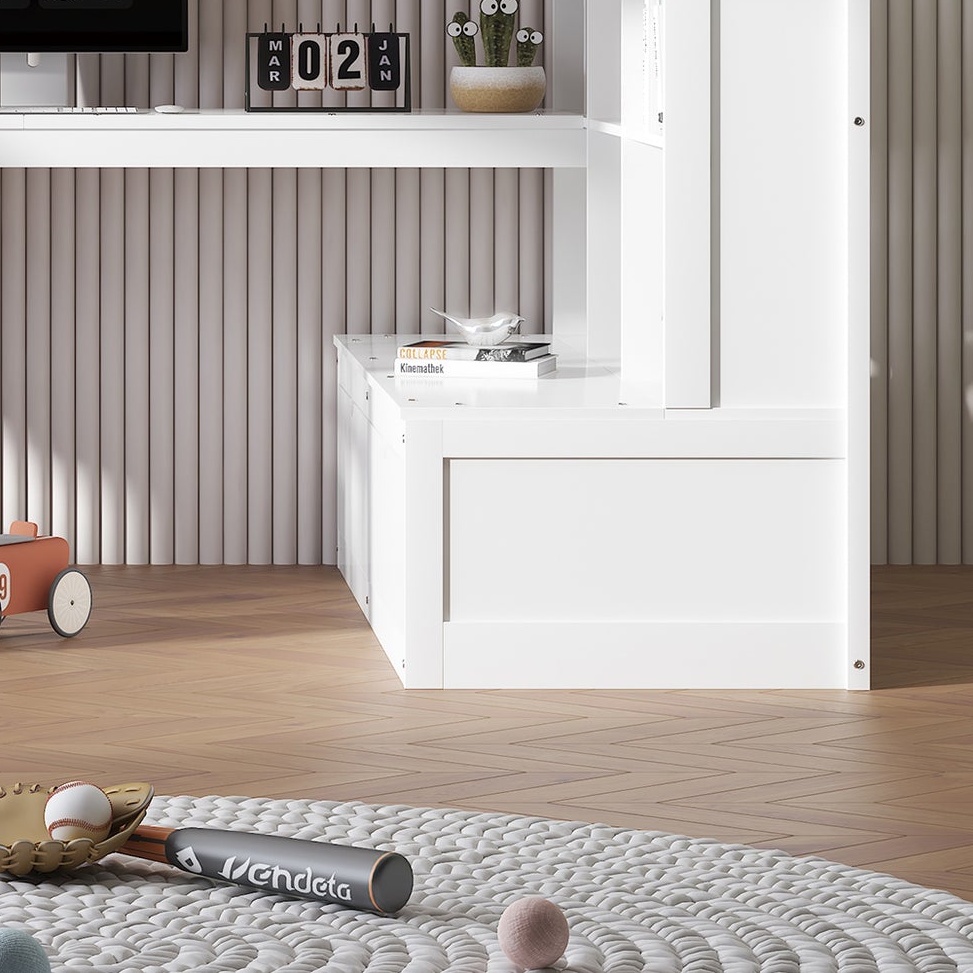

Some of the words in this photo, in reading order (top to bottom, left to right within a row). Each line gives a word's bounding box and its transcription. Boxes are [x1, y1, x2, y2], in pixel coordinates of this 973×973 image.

[268, 40, 283, 82] MAR
[378, 39, 392, 82] JAN
[399, 348, 447, 360] COLLAPSE
[400, 363, 445, 374] Kinemathek
